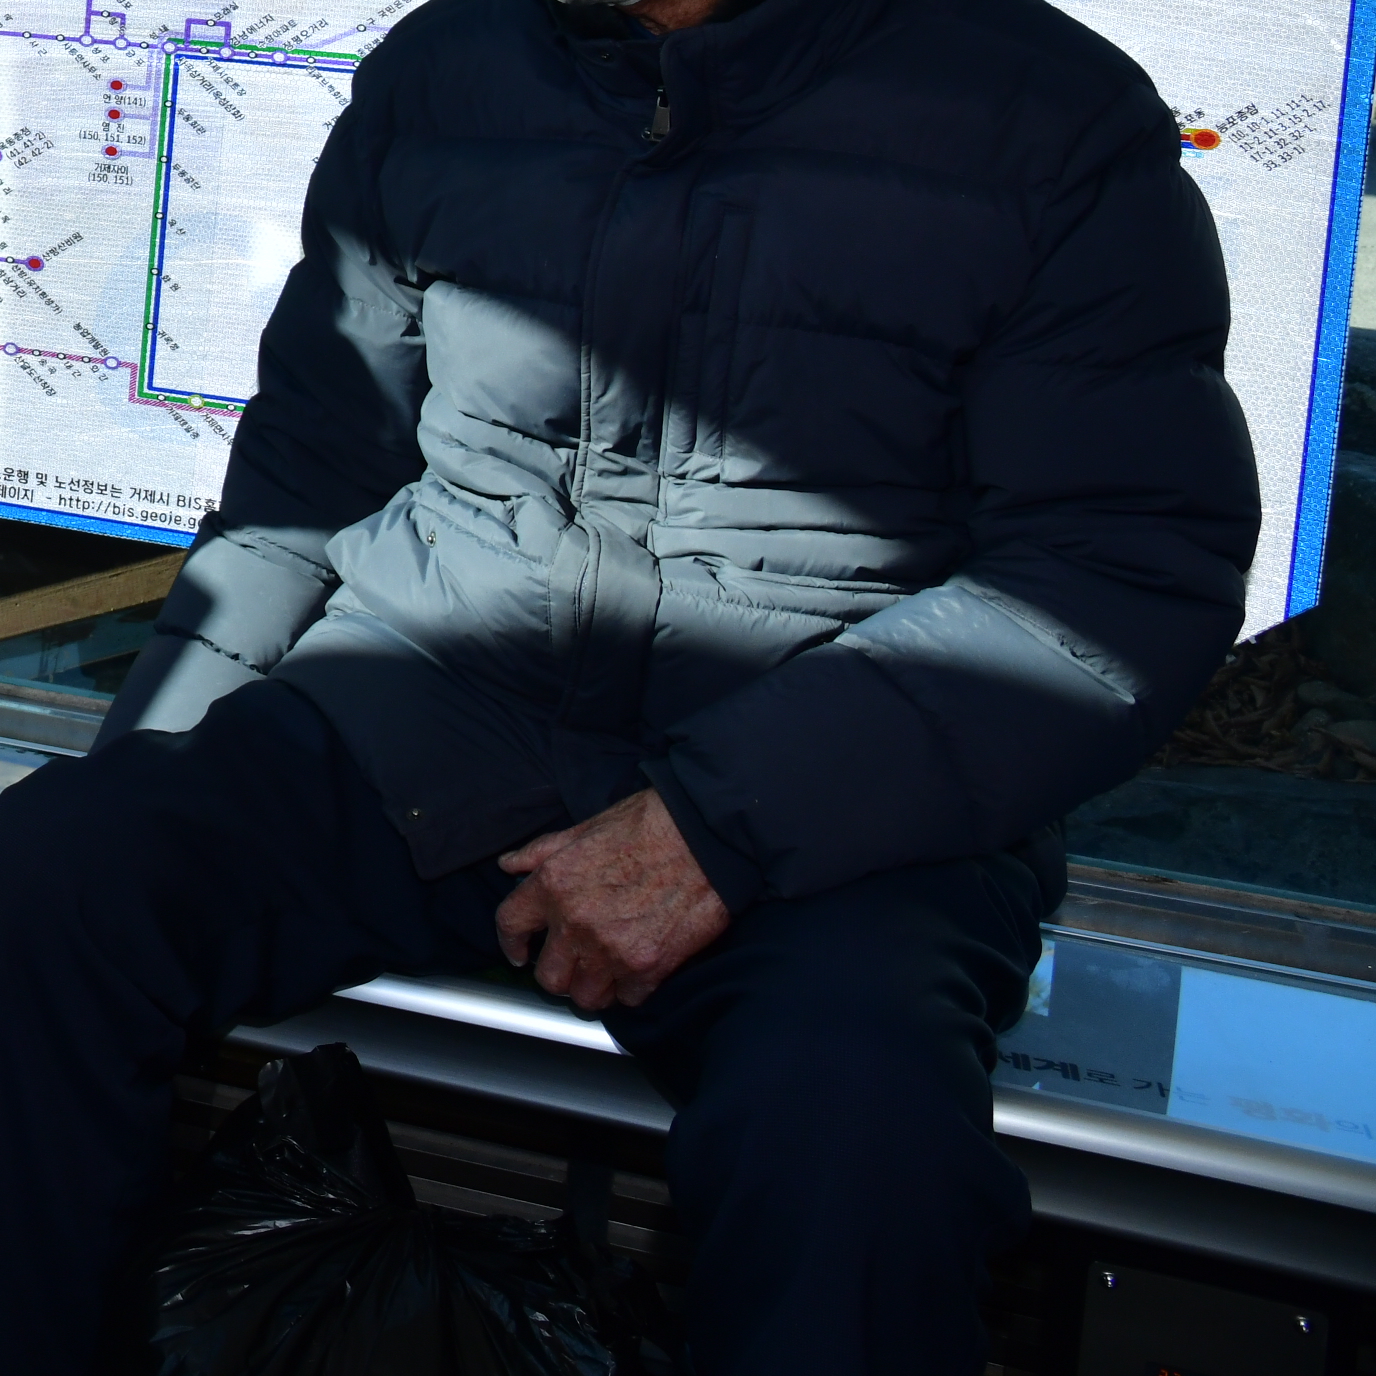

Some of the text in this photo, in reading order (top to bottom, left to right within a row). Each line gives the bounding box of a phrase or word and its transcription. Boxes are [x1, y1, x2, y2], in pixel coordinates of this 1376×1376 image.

[35, 471, 48, 488] 및
[53, 473, 123, 499] 노선정보는
[128, 485, 170, 506] 거제시
[176, 495, 222, 512] BIS홈
